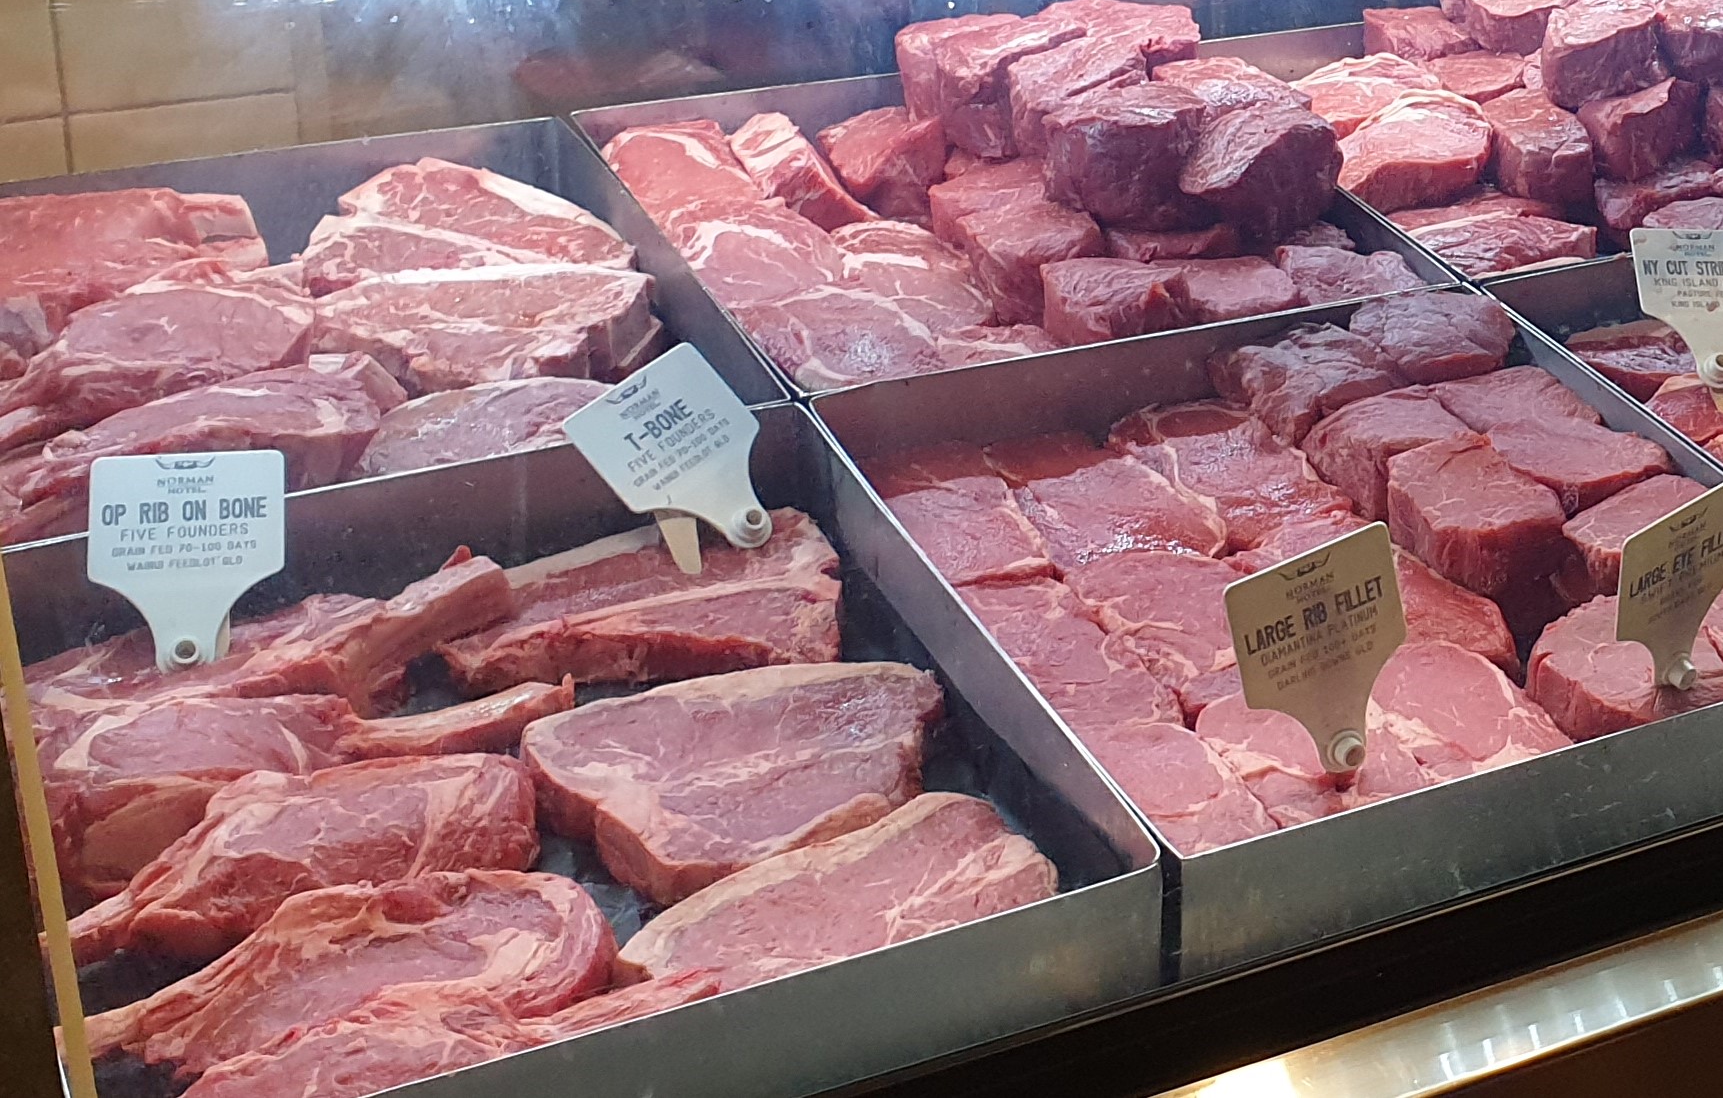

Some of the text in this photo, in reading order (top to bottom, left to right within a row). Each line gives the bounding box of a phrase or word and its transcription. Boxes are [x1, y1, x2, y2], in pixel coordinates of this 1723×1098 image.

[1642, 259, 1659, 276] NY
[1665, 259, 1688, 276] CUT
[1653, 277, 1678, 287] KING
[1682, 277, 1719, 288] ISLAND
[624, 398, 693, 451] T-BONE
[627, 408, 715, 473] FIVE FOUNDERS
[156, 475, 214, 487] NORMAN
[101, 496, 267, 526] OP RIB ON BONE
[119, 522, 248, 542] FIVE FOUNDERS
[1629, 562, 1667, 599] LARGE
[1244, 575, 1383, 655] LARGE RIB FILLET
[1260, 604, 1378, 666] DIAMANTINA PLATINUM
